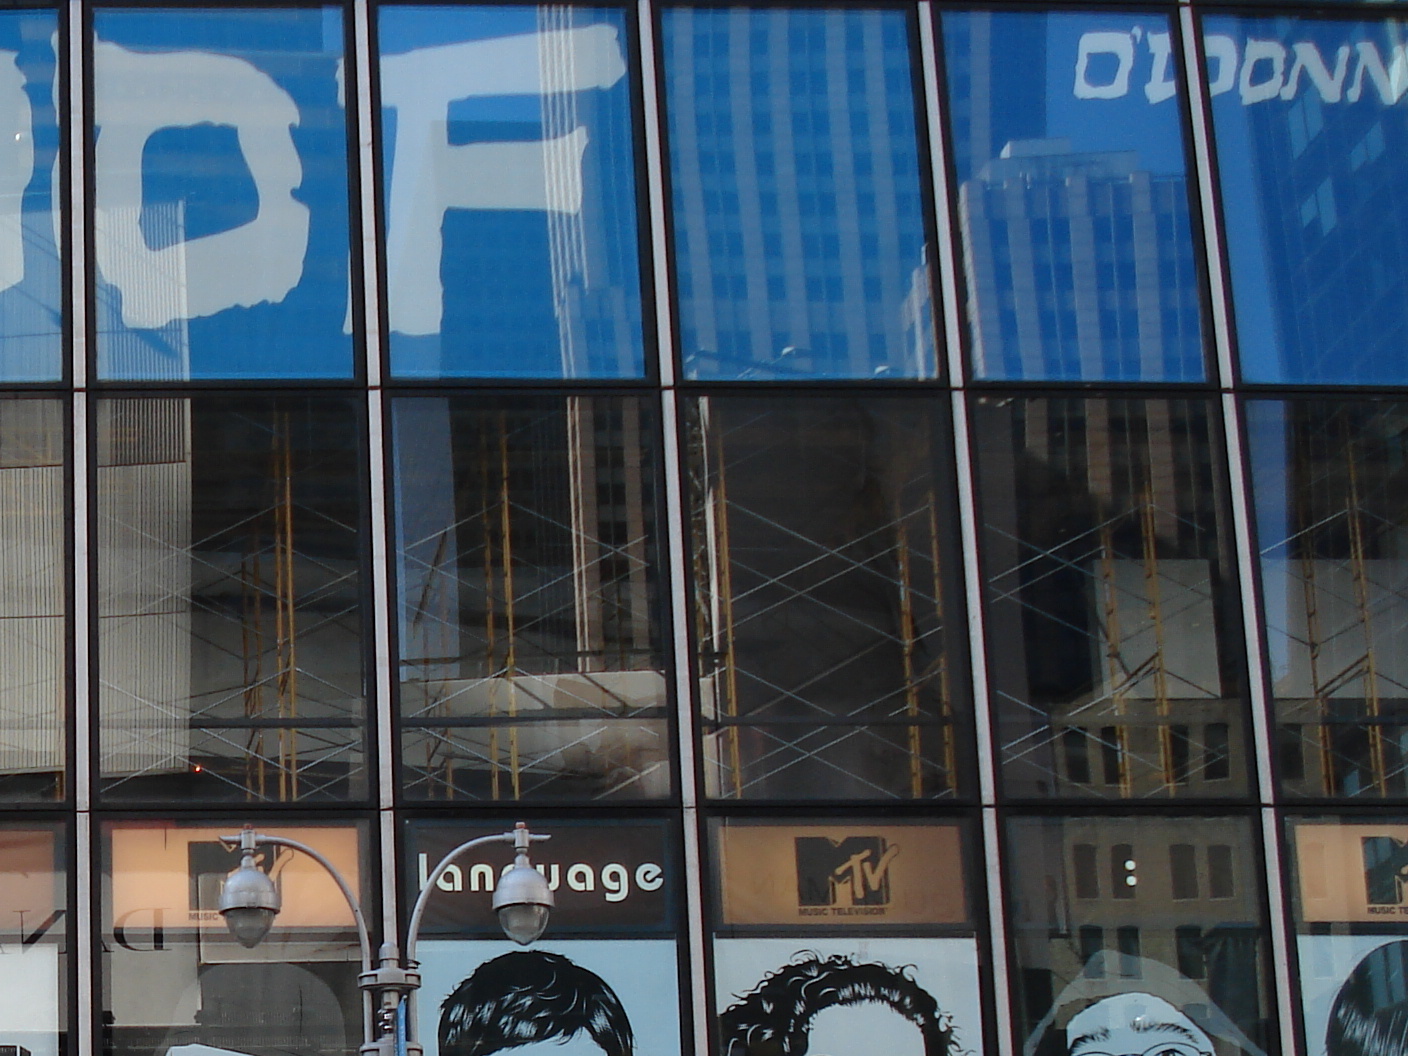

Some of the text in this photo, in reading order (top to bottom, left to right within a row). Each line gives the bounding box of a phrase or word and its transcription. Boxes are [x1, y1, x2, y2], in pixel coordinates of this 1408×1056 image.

[418, 853, 664, 902] lanuage
[795, 836, 900, 907] MTV
[188, 912, 220, 921] MUSIC
